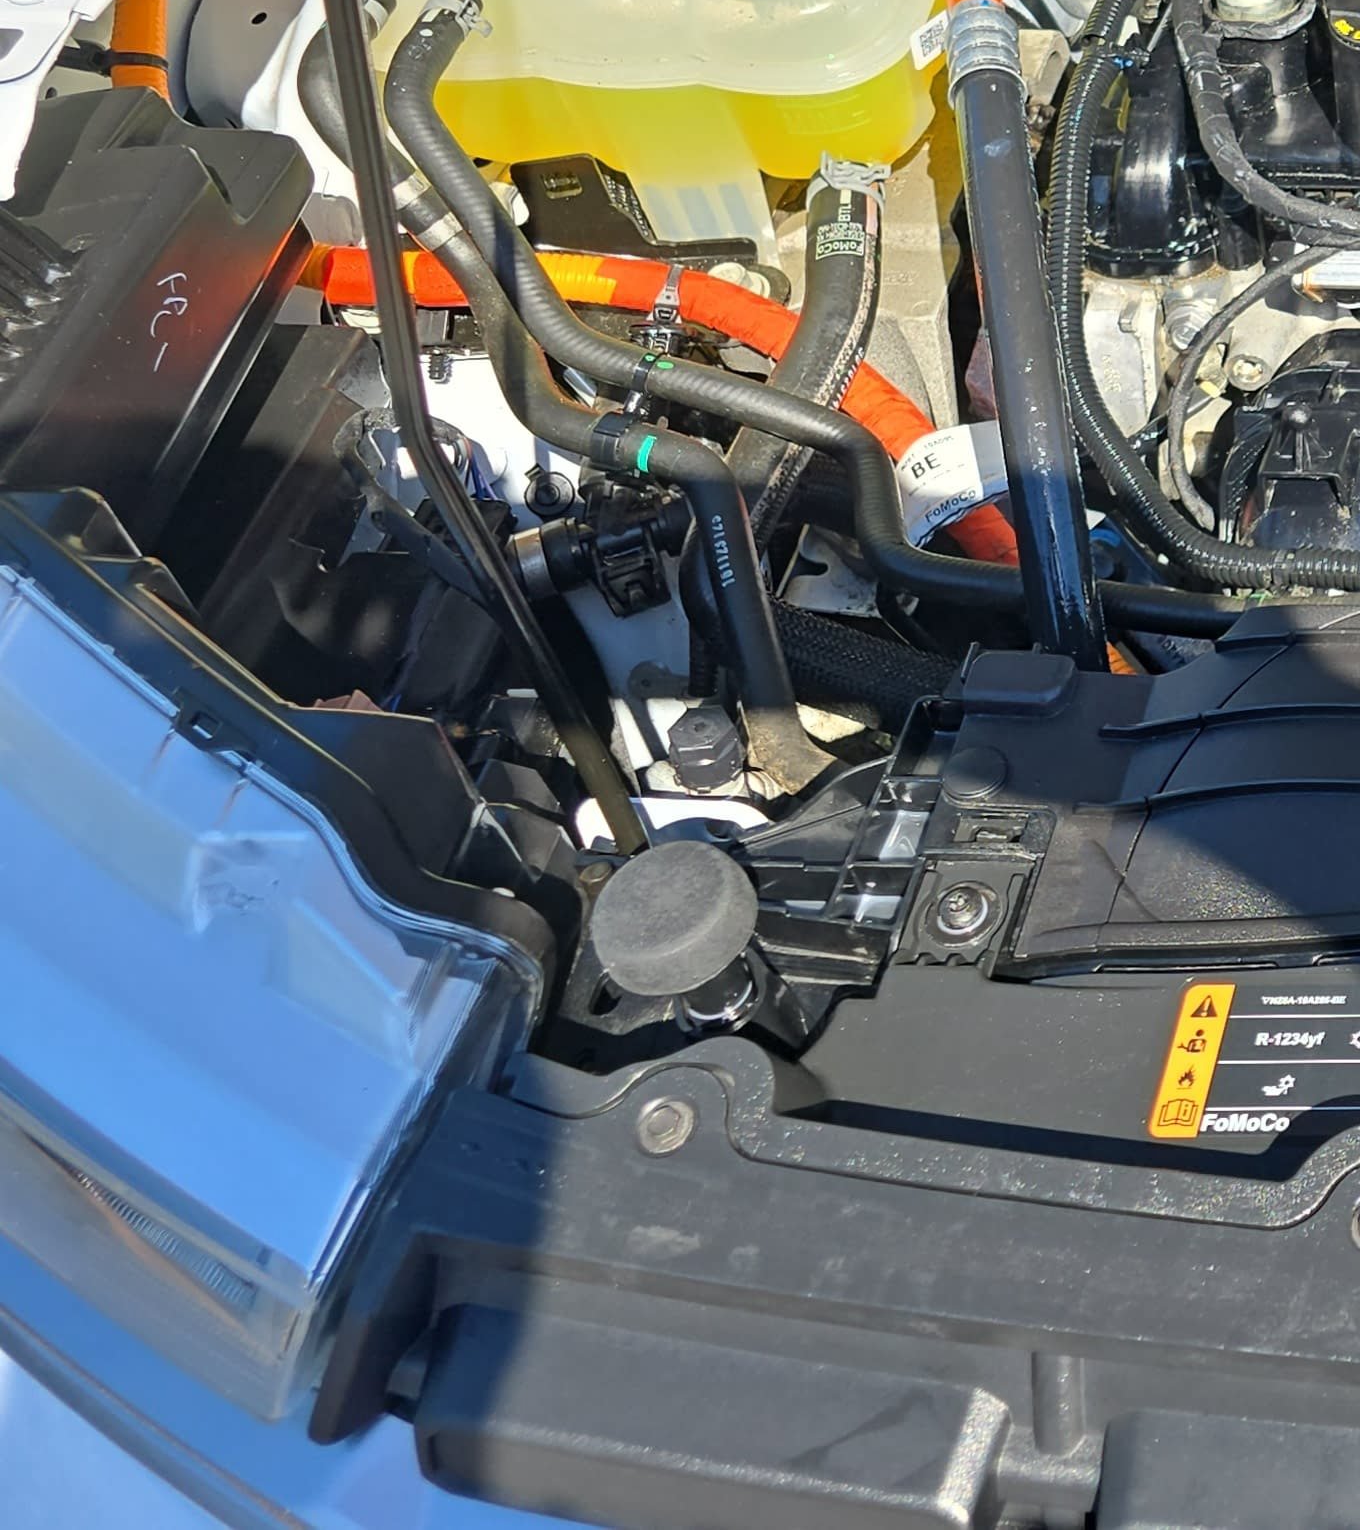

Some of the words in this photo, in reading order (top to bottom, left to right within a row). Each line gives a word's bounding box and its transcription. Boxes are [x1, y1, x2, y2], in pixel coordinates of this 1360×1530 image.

[816, 240, 864, 255] FoMoCo
[911, 452, 942, 480] BE
[924, 489, 977, 523] FoMoCo
[1254, 1031, 1326, 1049] R-1234yf
[1200, 1113, 1290, 1132] FoMoCo
